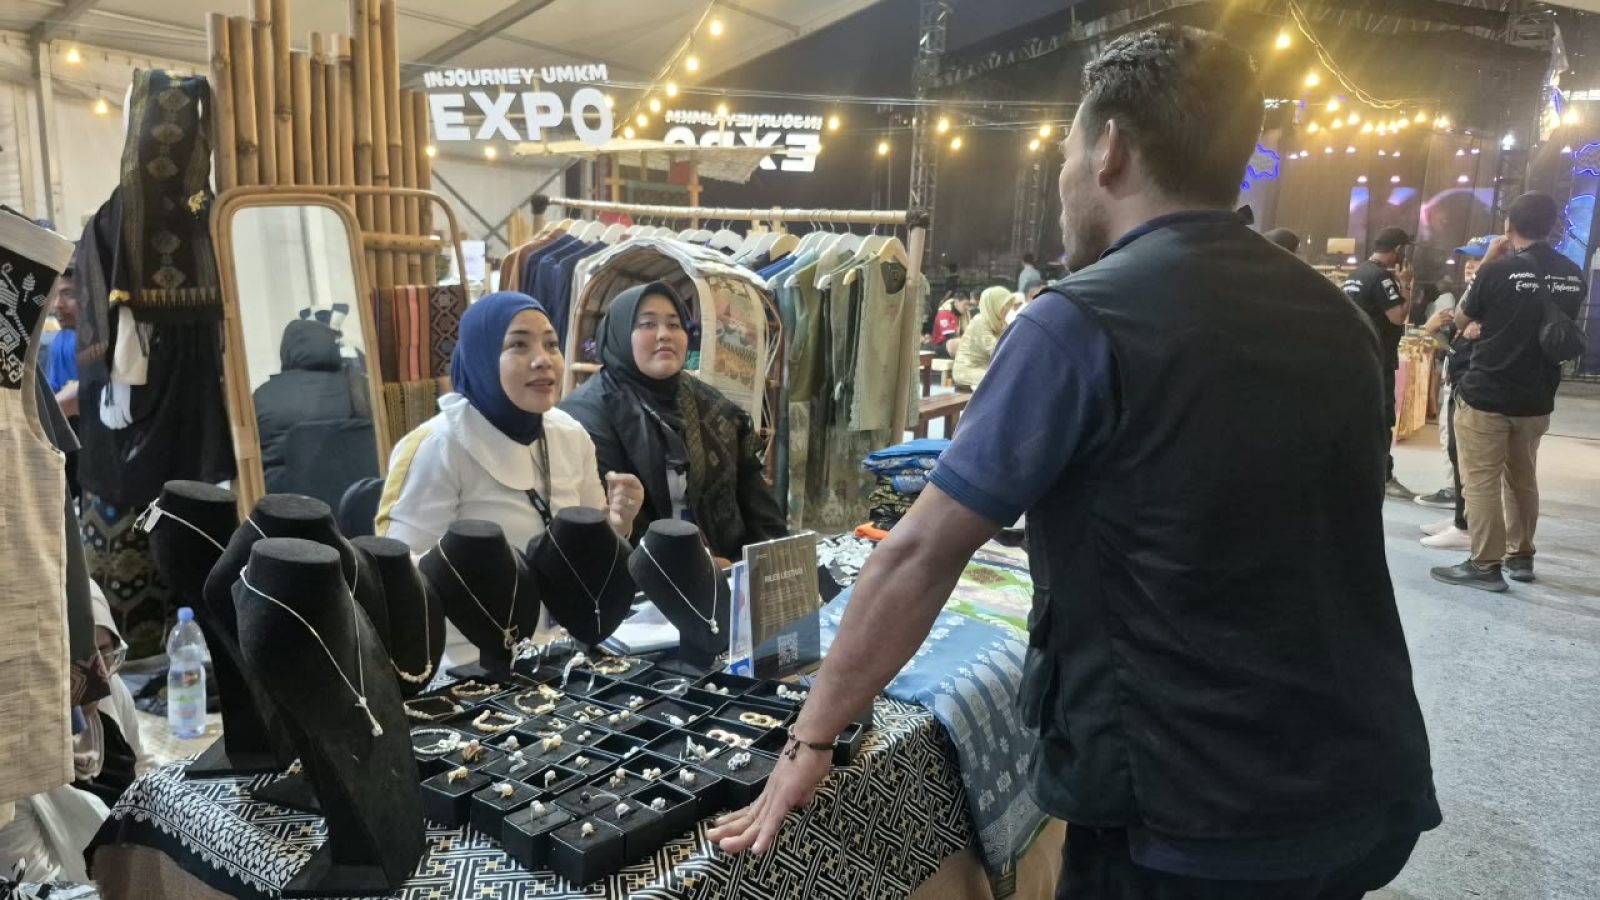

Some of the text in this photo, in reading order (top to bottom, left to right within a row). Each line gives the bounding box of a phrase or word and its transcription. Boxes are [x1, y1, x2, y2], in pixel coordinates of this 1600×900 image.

[423, 63, 609, 88] INJOURNEY UMKM
[429, 87, 614, 147] EXPO
